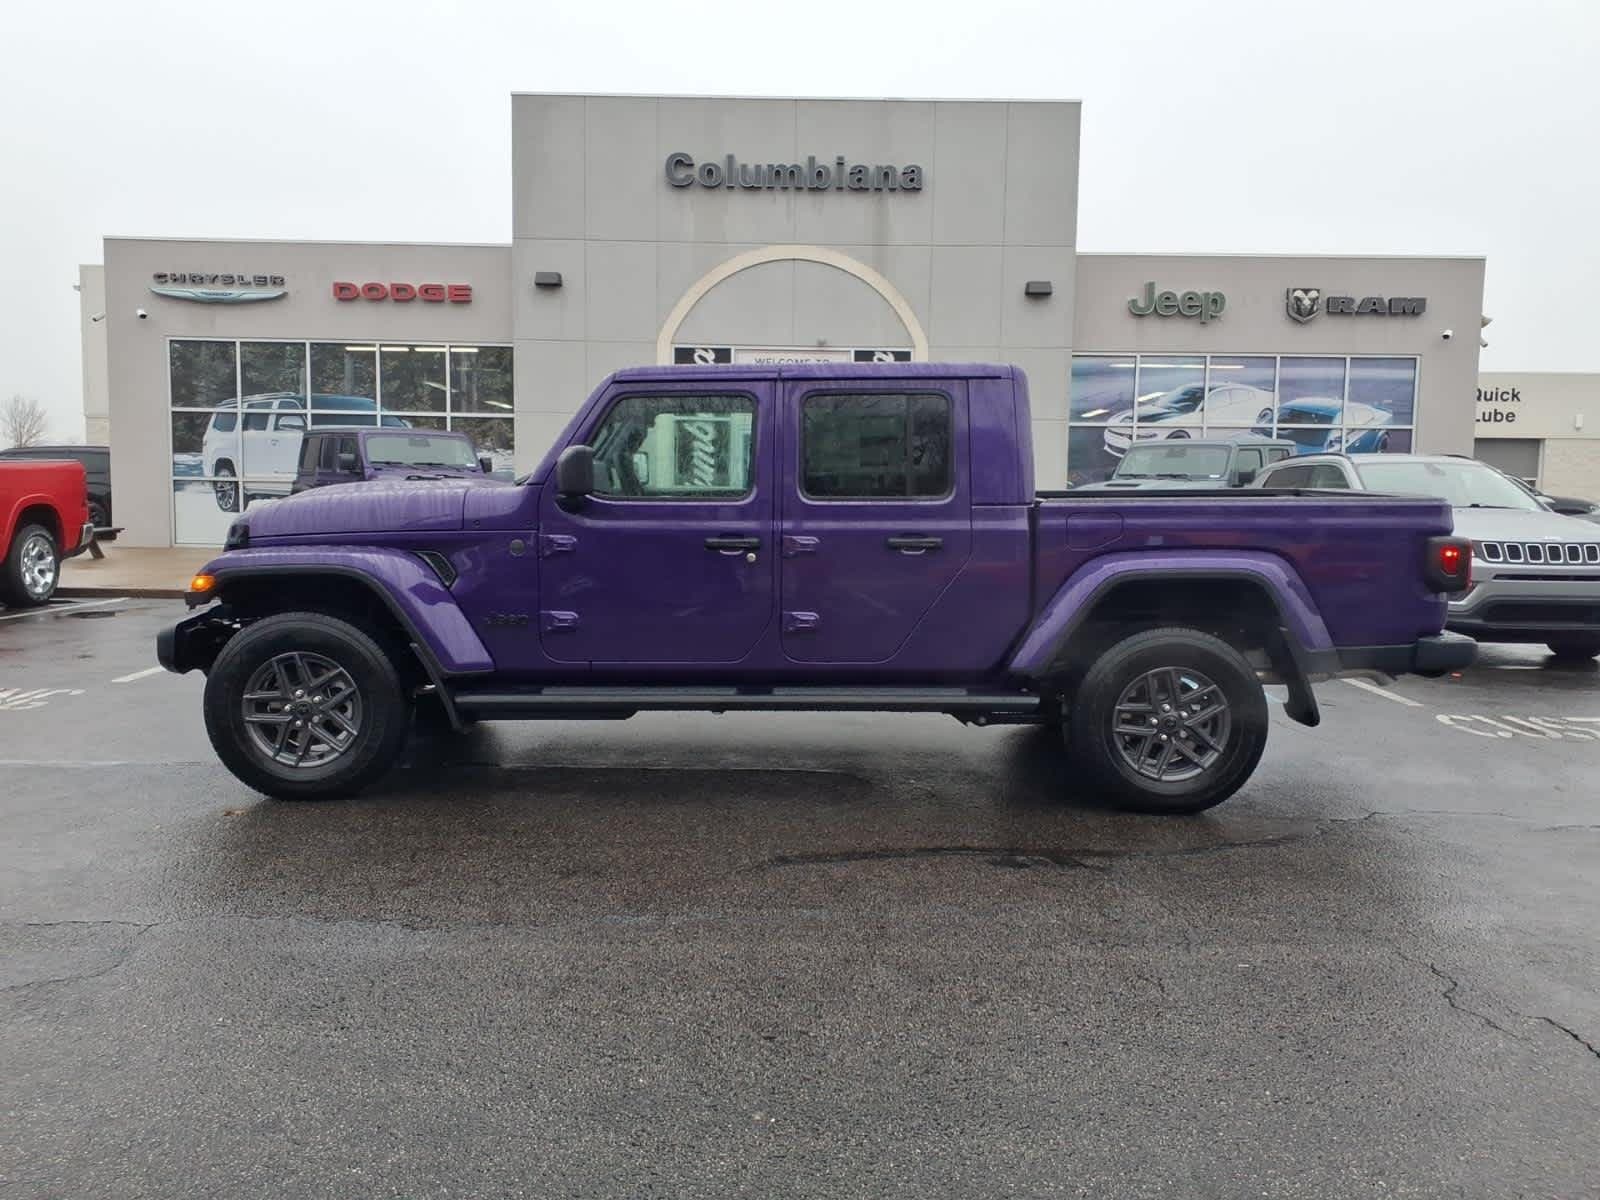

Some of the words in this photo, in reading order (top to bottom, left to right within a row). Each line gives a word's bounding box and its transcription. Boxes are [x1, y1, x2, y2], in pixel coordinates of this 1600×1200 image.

[665, 152, 922, 191] Columbiana
[153, 272, 285, 286] CHRYSLER
[333, 282, 472, 303] DODGE
[1128, 281, 1226, 323] Jeep
[1326, 296, 1427, 316] RAM
